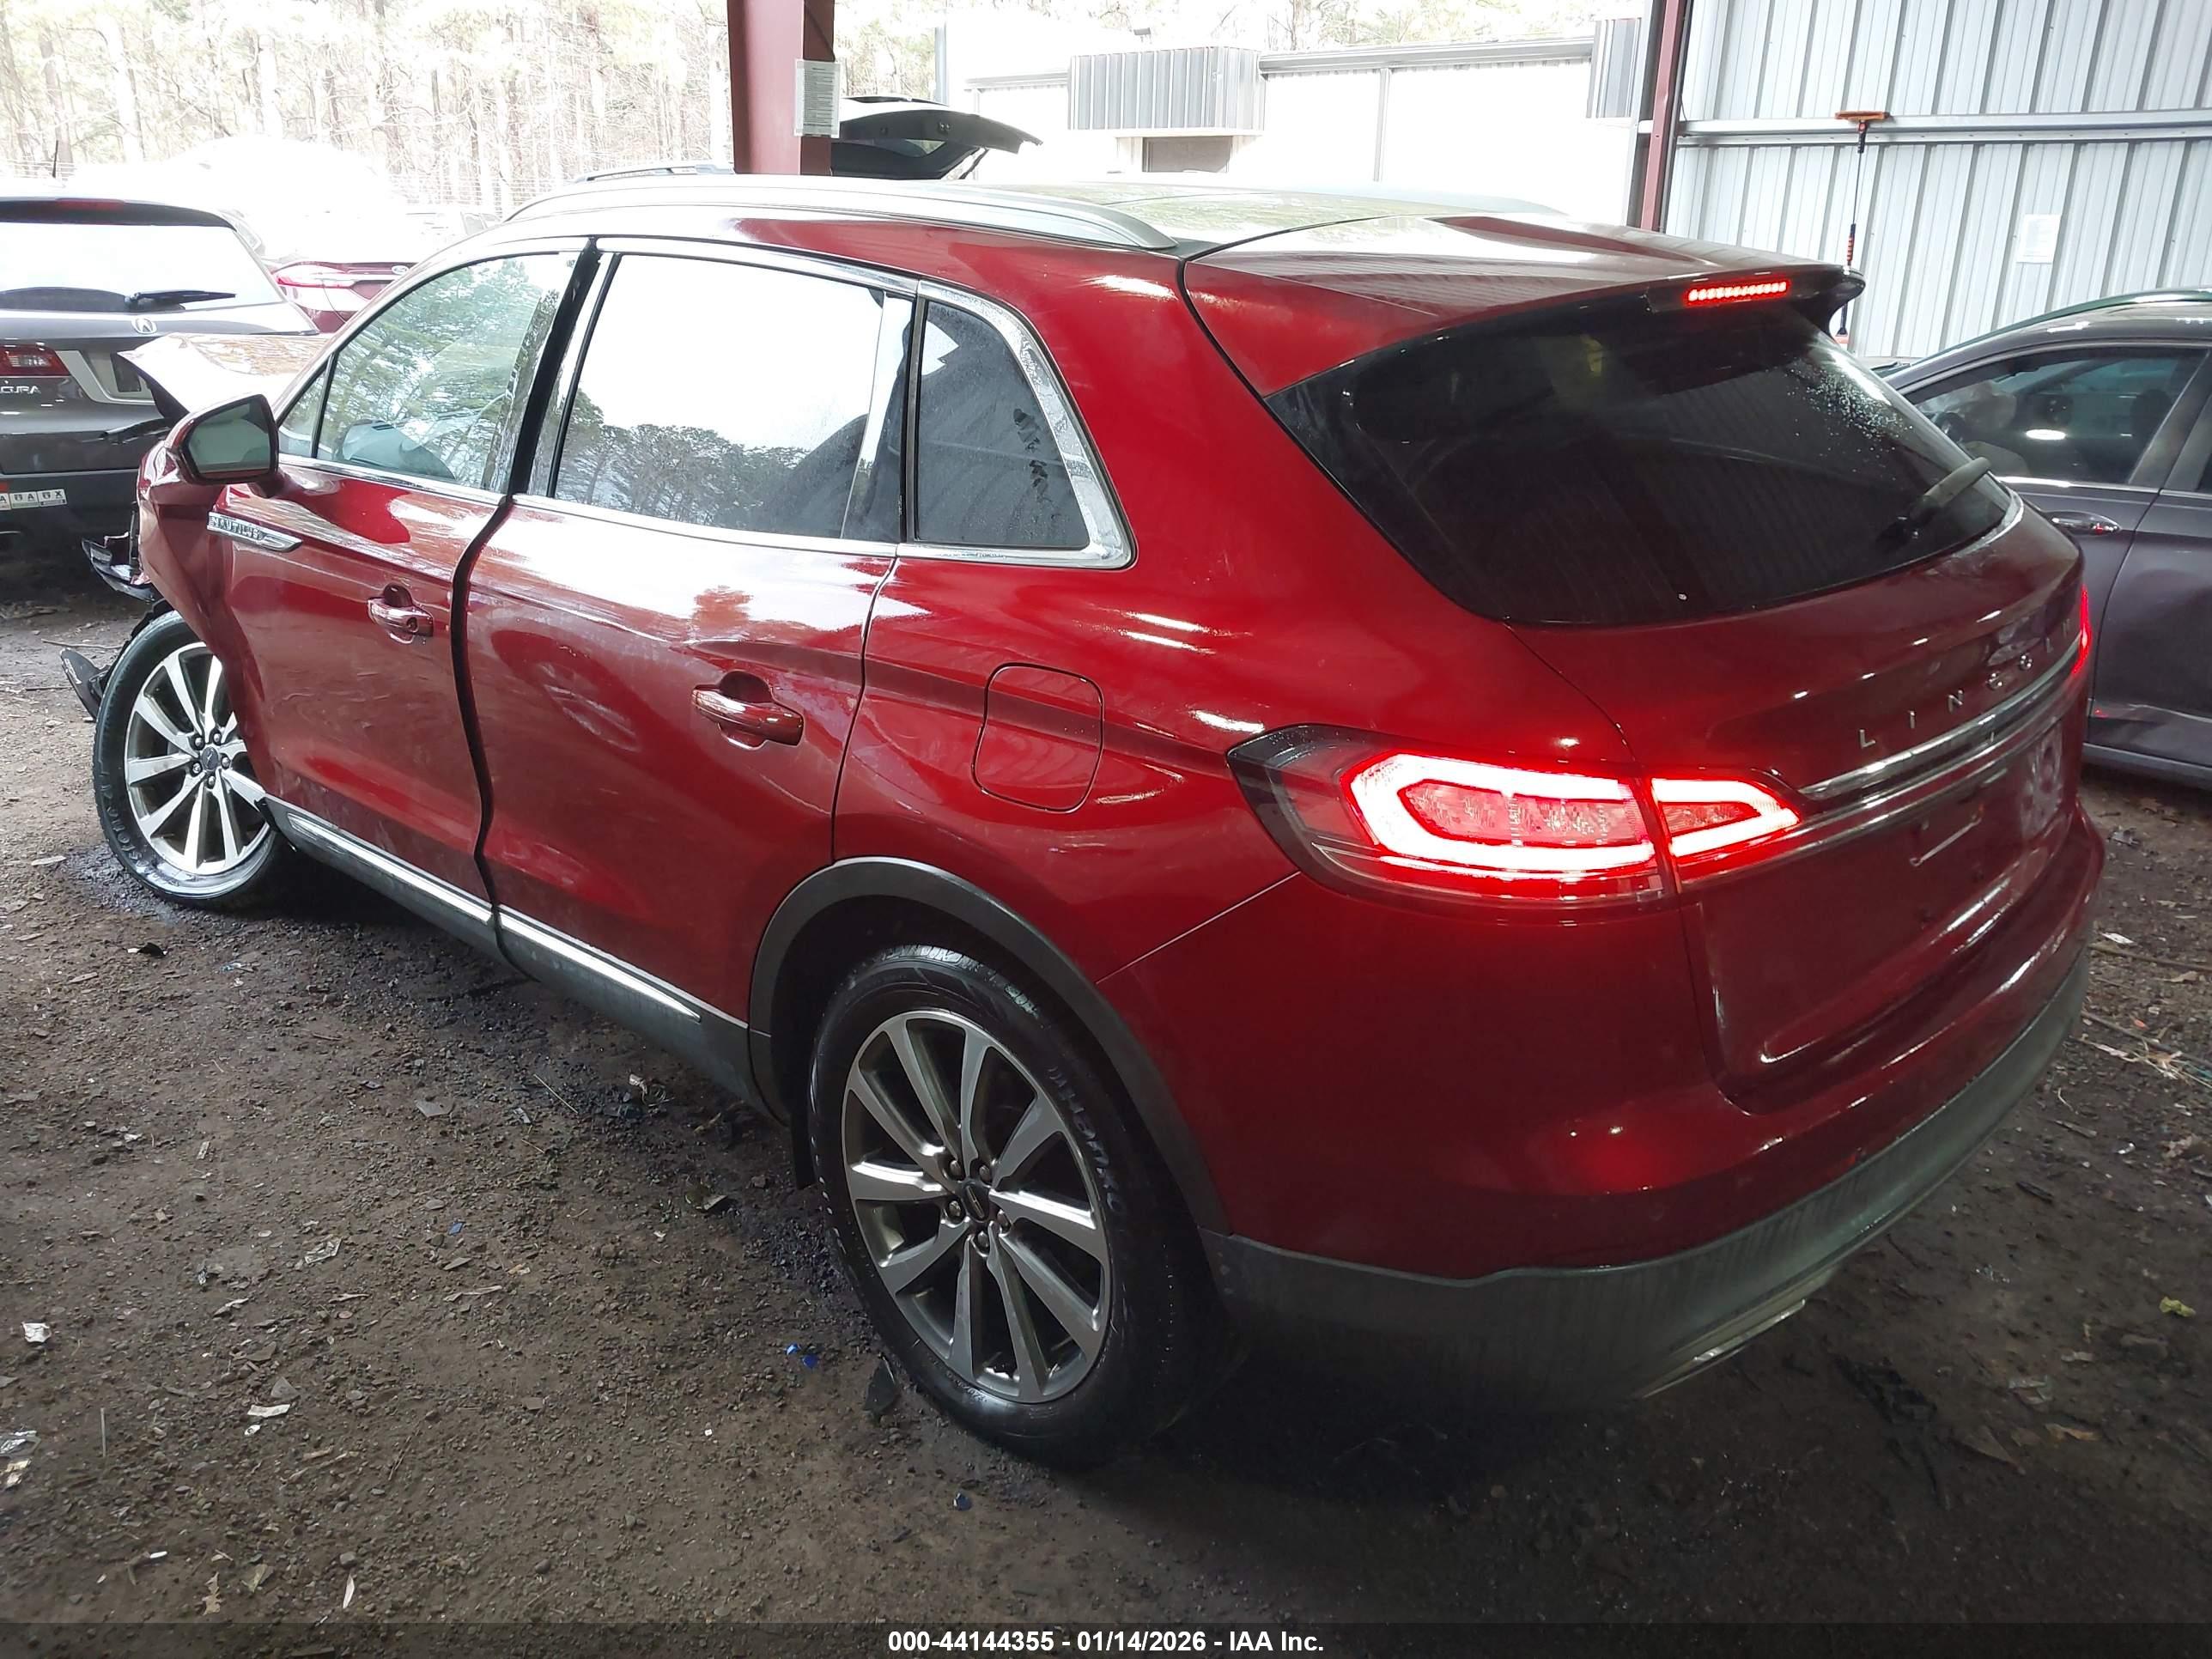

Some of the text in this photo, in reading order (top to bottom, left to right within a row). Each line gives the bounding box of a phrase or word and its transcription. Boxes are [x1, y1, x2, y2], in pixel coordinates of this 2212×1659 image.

[0, 386, 41, 395] CURA
[212, 515, 264, 541] NAUTILUS
[1858, 618, 2072, 750] LINCOLN
